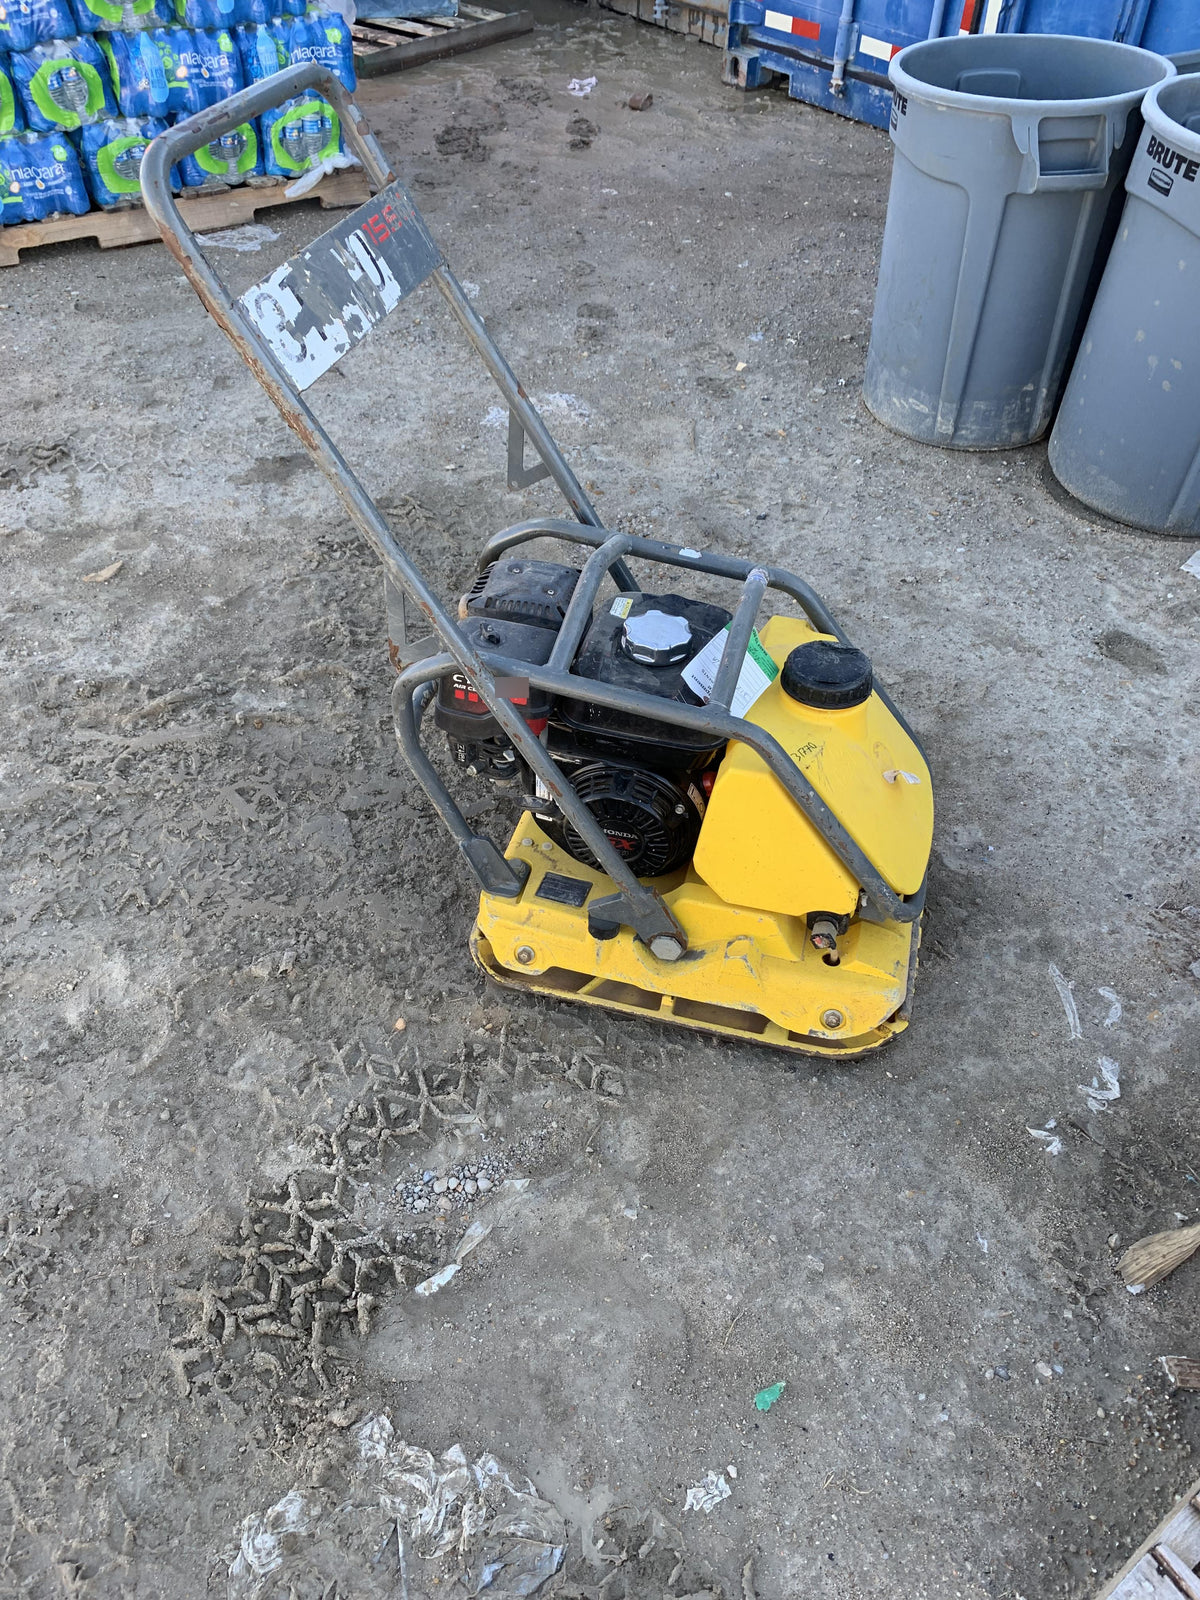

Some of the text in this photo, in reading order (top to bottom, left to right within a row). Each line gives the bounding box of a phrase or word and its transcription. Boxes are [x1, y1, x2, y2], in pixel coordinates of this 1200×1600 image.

[180, 51, 229, 73] niagara
[291, 46, 337, 64] niagara
[1146, 135, 1200, 182] BRUTE
[11, 163, 65, 183] niagara
